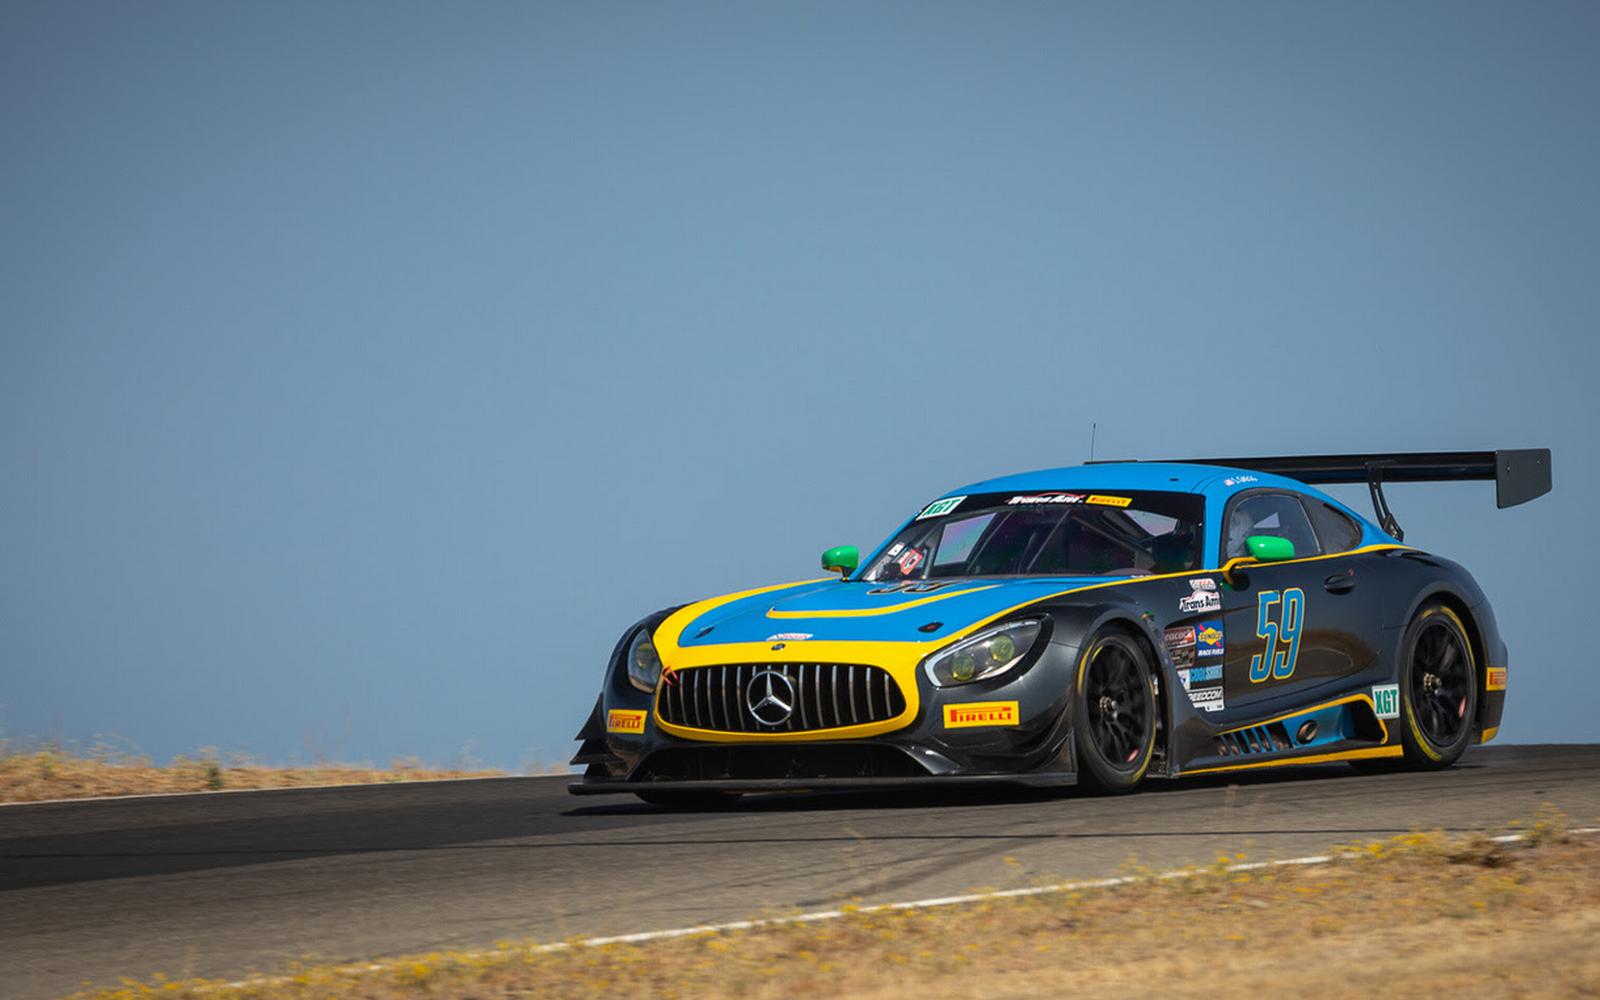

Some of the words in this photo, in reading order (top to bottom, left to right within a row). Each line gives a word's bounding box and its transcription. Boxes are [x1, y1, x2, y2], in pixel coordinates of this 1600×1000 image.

[1182, 599, 1205, 610] Trans
[1198, 631, 1222, 641] SUNOCO
[1249, 587, 1305, 683] 59
[1374, 689, 1398, 714] XGT
[609, 714, 641, 728] PIRELLI
[950, 706, 1012, 722] PIRELLI
